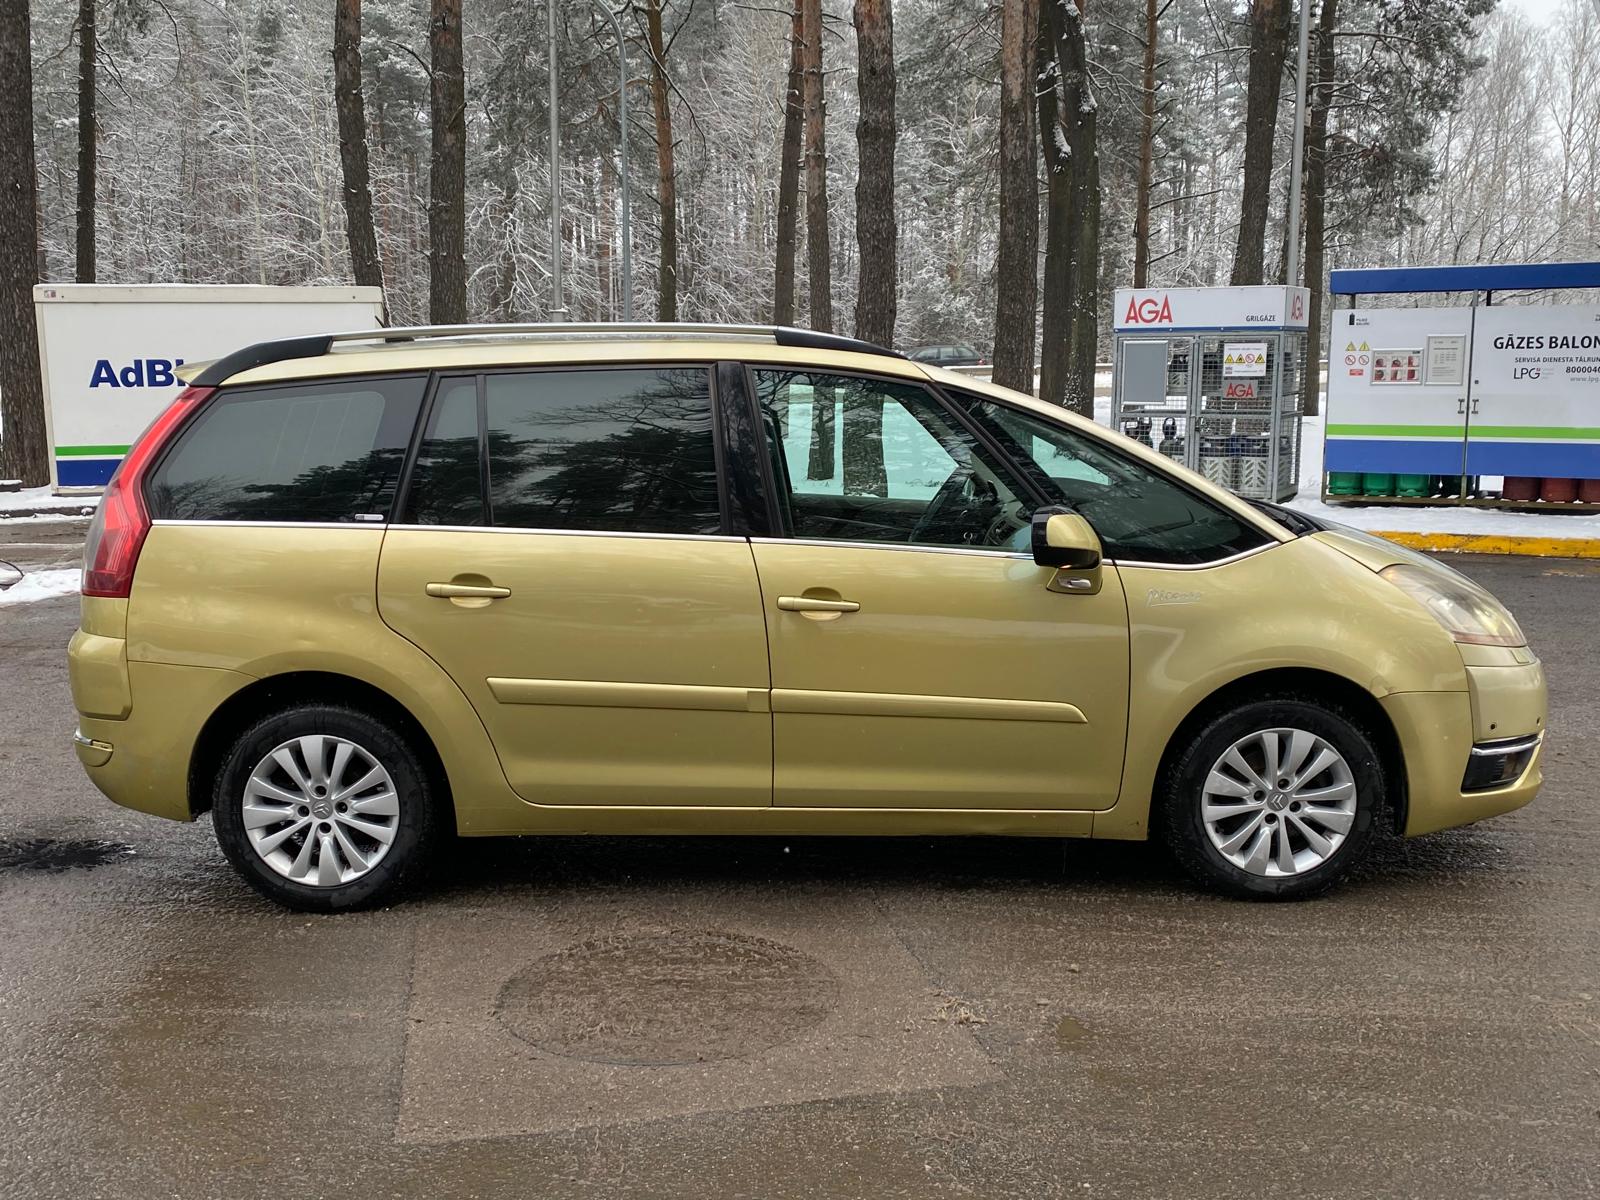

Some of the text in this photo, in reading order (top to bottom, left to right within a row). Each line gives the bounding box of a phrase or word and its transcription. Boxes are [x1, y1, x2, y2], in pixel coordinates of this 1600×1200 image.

[1125, 293, 1173, 324] AGA
[1291, 294, 1303, 320] AGA
[1493, 333, 1544, 349] GĀZES
[1513, 367, 1541, 379] LPG
[1226, 383, 1254, 397] AGA
